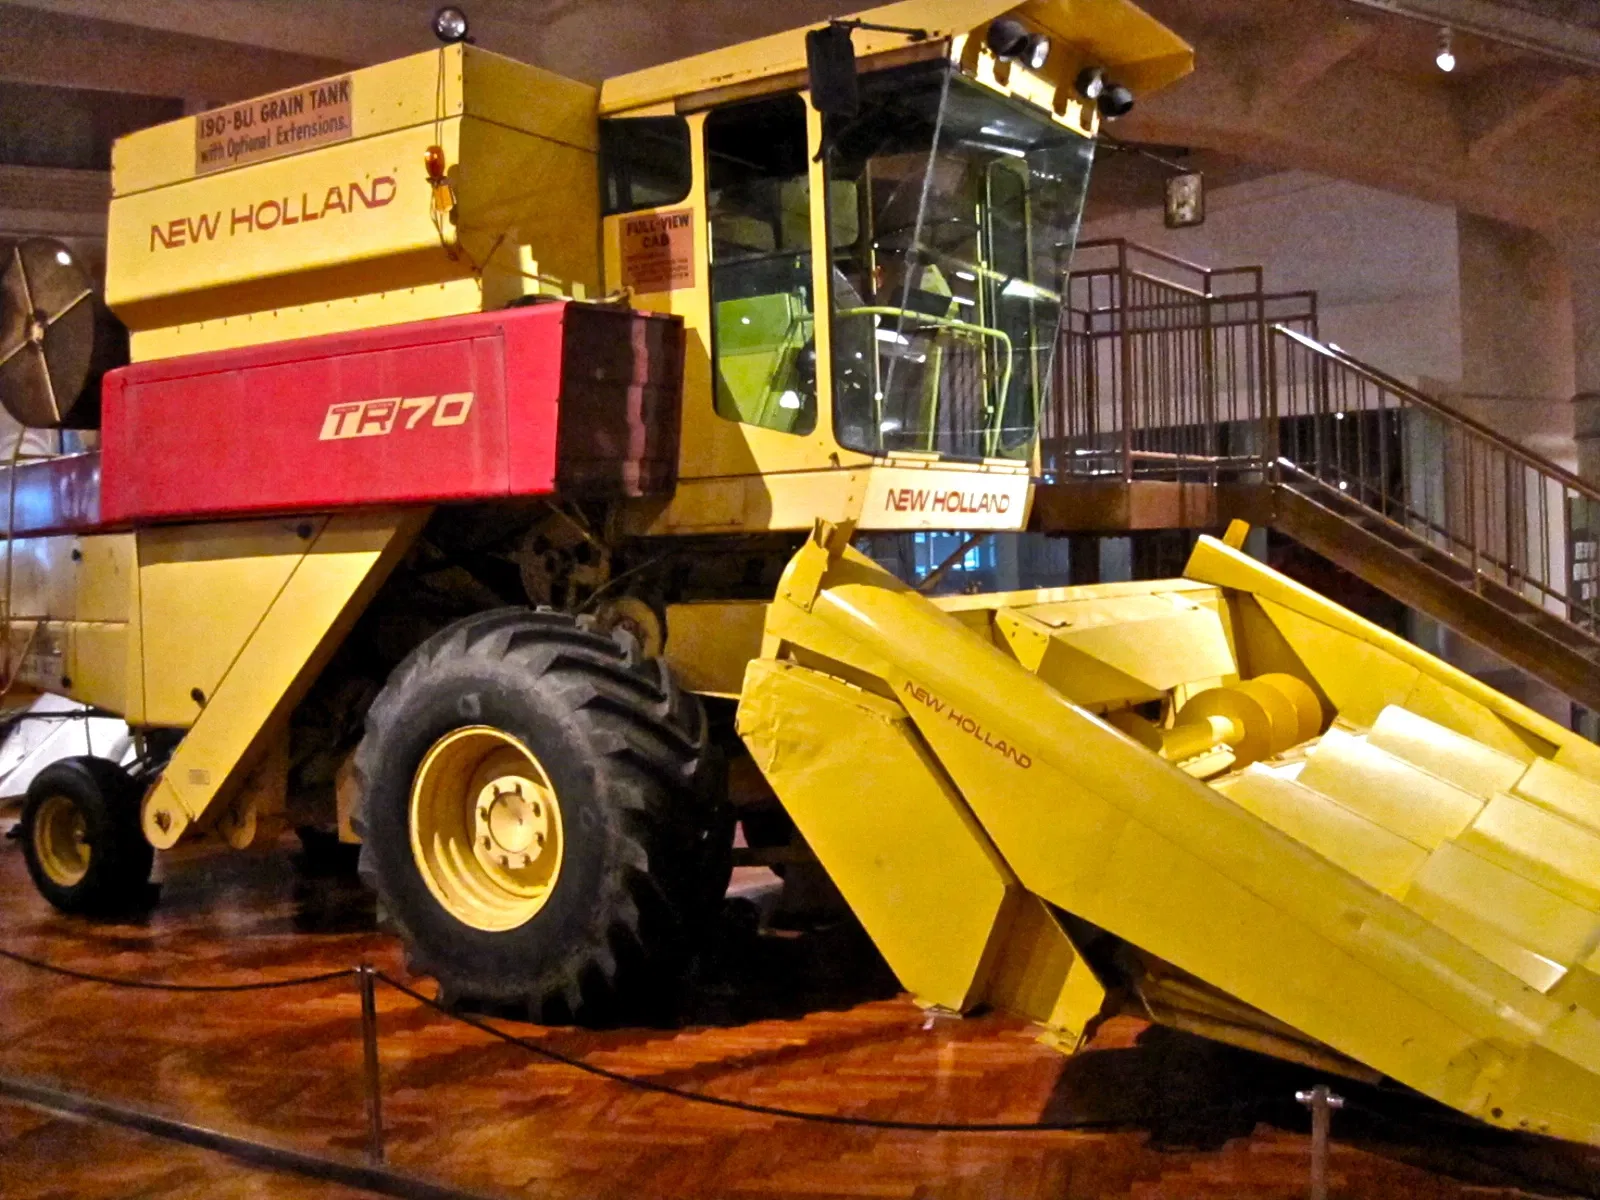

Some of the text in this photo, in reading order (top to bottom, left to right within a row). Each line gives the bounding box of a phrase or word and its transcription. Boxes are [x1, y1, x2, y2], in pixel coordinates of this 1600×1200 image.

[260, 94, 304, 123] GRAIN
[309, 80, 349, 110] TANK
[227, 127, 271, 162] Optional
[150, 176, 397, 252] NEW HOLLAND
[885, 488, 1010, 514] NEW HOLLAND
[904, 680, 1032, 769] NEW HOLLAND
